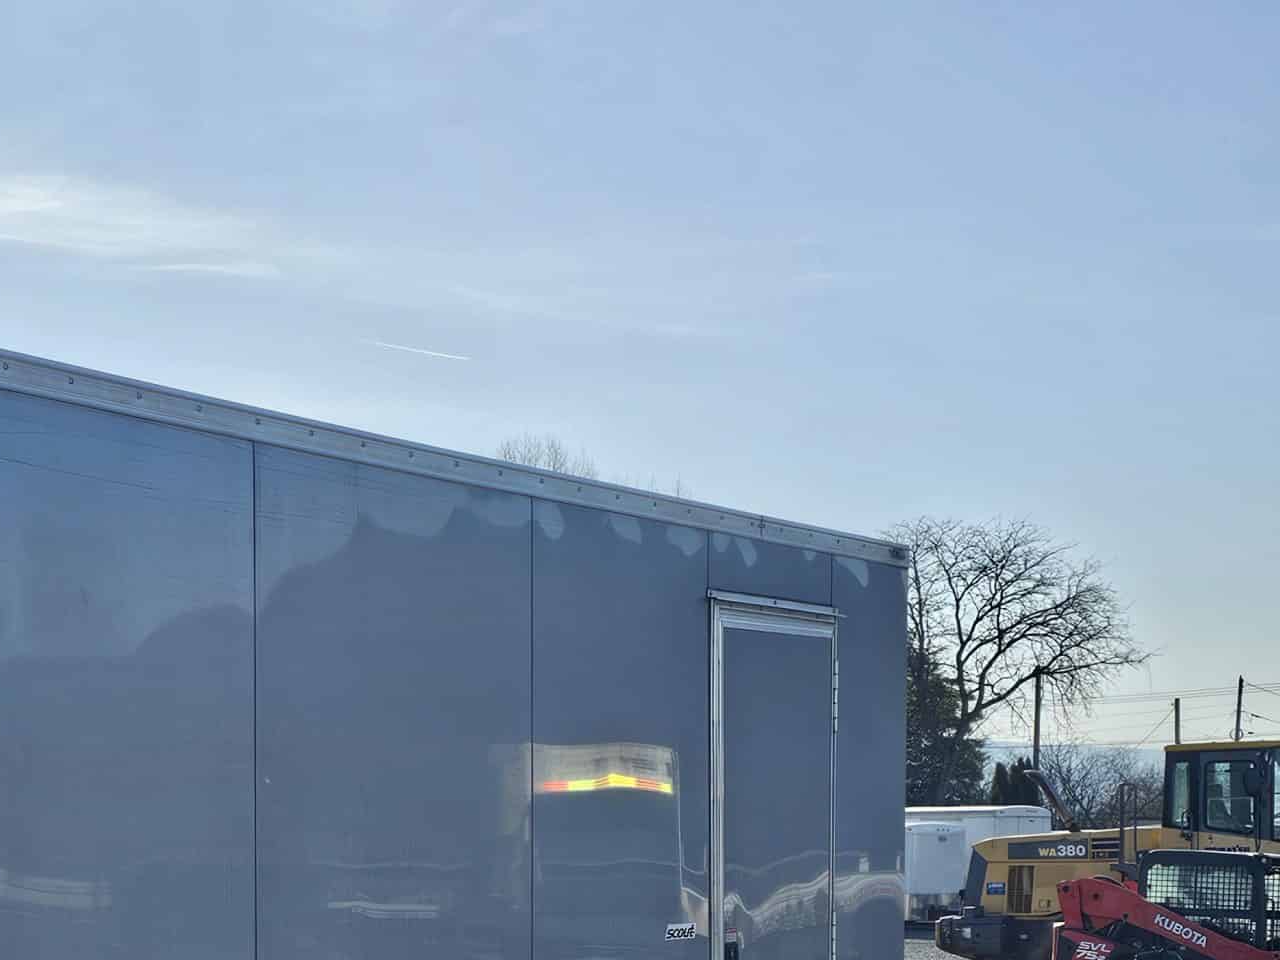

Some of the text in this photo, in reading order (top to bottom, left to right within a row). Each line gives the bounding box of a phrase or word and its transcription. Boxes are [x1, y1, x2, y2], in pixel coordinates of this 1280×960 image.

[1039, 845, 1086, 857] WA380
[1154, 913, 1208, 948] KUBOTA
[1078, 941, 1111, 953] SVL
